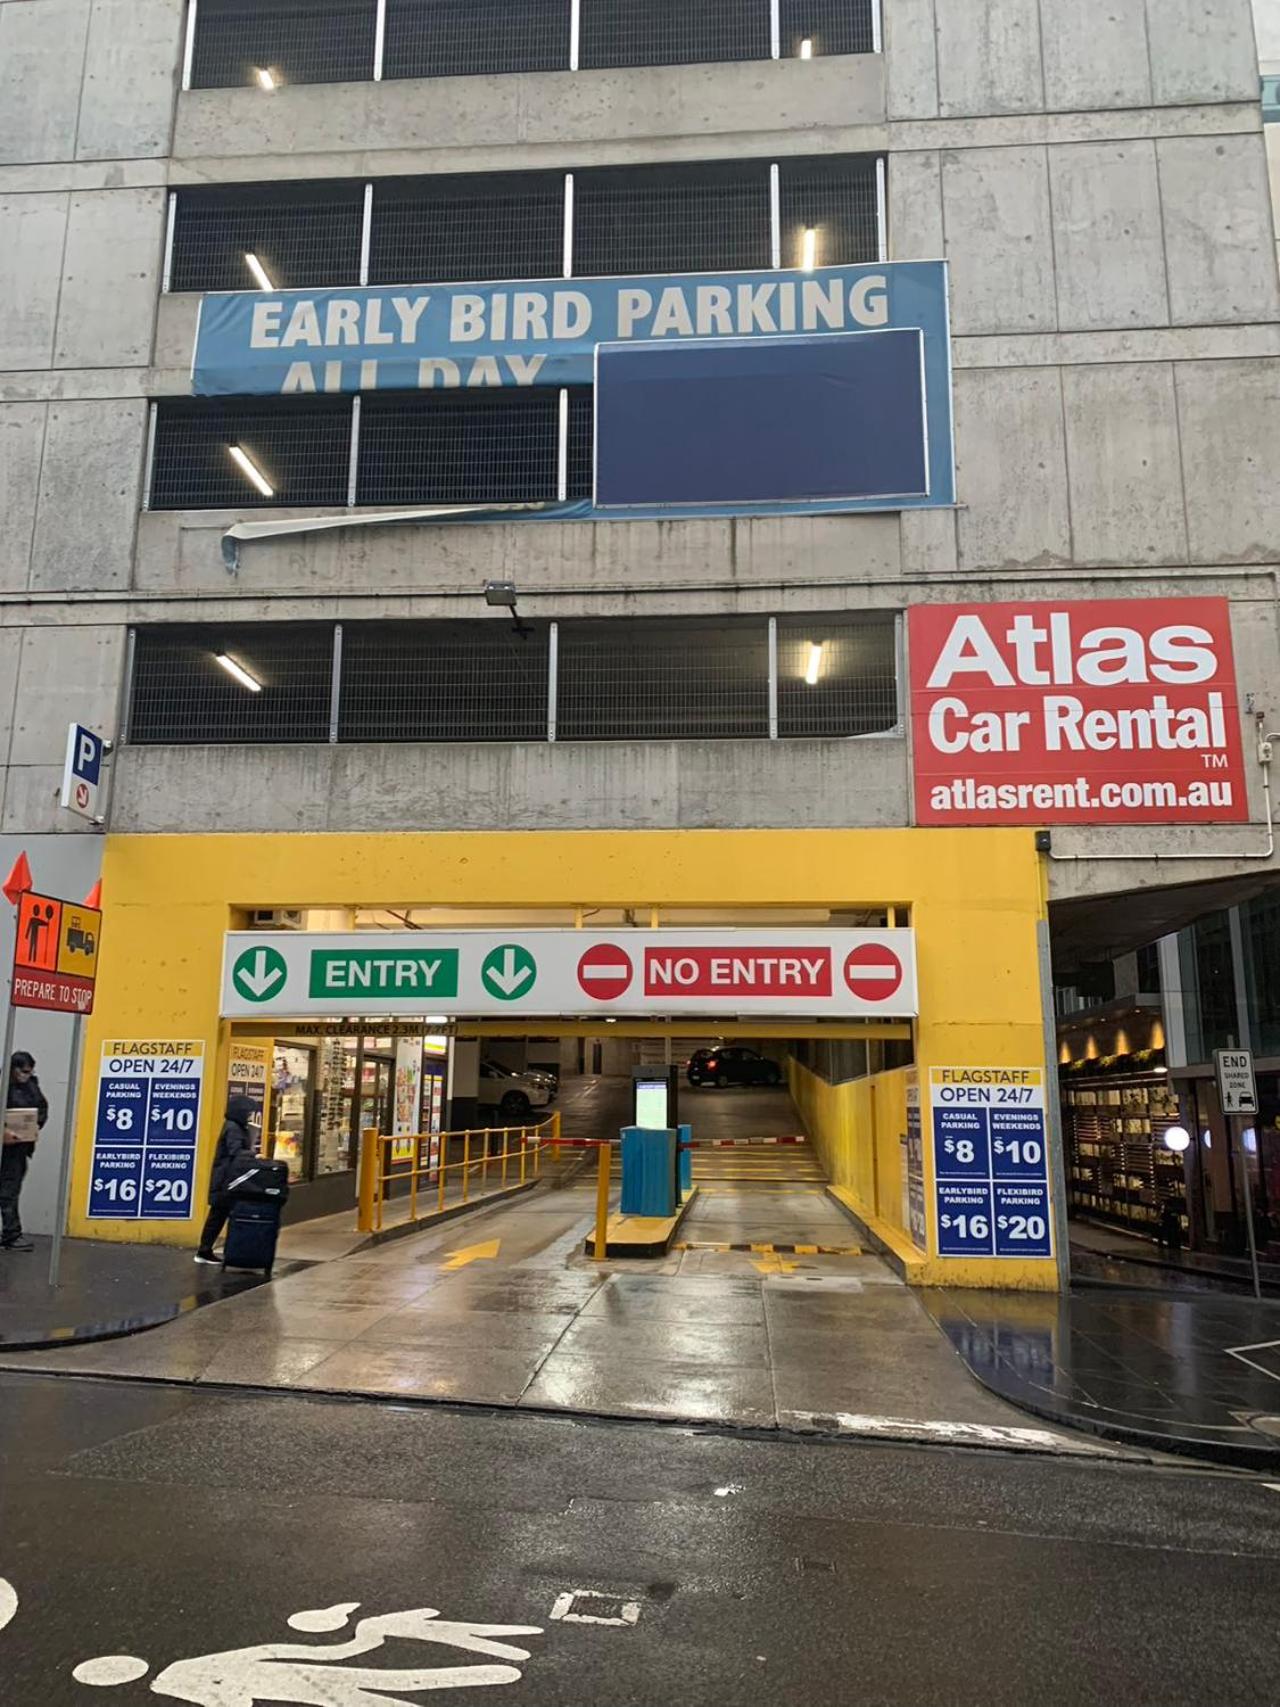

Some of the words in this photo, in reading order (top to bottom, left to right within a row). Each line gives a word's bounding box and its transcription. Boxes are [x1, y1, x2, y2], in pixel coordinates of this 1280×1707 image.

[250, 296, 431, 348] EARLY
[450, 291, 592, 342] BIRD
[617, 275, 889, 337] PARKING
[926, 612, 1218, 688] Atlas
[928, 697, 1031, 753] Car
[1043, 692, 1227, 751] Rental
[77, 734, 96, 771] P
[1201, 755, 1228, 768] TM
[931, 777, 1233, 810] atlasrent.com.au
[325, 959, 442, 988] ENTRY
[649, 958, 700, 986] NO
[711, 957, 825, 986] ENTRY
[14, 978, 57, 1001] PREPARE
[59, 985, 71, 1003] TO
[71, 988, 93, 1004] STOP
[295, 1024, 323, 1035] MAX.
[326, 1024, 391, 1035] CLEARANCE
[392, 1024, 419, 1035] 2.3M
[113, 1042, 193, 1055] FLAGSTAFF
[109, 1059, 154, 1073] OPEN
[160, 1059, 194, 1074] 24/7
[1223, 1055, 1248, 1067] END
[942, 1070, 1030, 1084] FLAGSTAFF
[152, 1091, 197, 1099] WEEKENDS
[940, 1087, 990, 1102] OPEN
[996, 1087, 1034, 1103] 24/7
[106, 1107, 133, 1130] $8
[151, 1108, 194, 1130] $10
[941, 1121, 981, 1129] PARKING
[942, 1112, 978, 1120] CASUAL
[993, 1113, 1039, 1121] EVENINGS
[992, 1122, 1041, 1130] WEEKENDS
[944, 1139, 975, 1163] $8
[993, 1140, 1041, 1164] $10
[94, 1178, 137, 1201] $16
[145, 1179, 189, 1202] $20
[938, 1187, 989, 1195] EARLYBIRD
[996, 1188, 1044, 1196] FLEXIBIRD
[944, 1196, 984, 1204] PARKING
[1001, 1197, 1041, 1205] PARKING
[940, 1214, 989, 1239] $16
[997, 1215, 1046, 1240] $20
